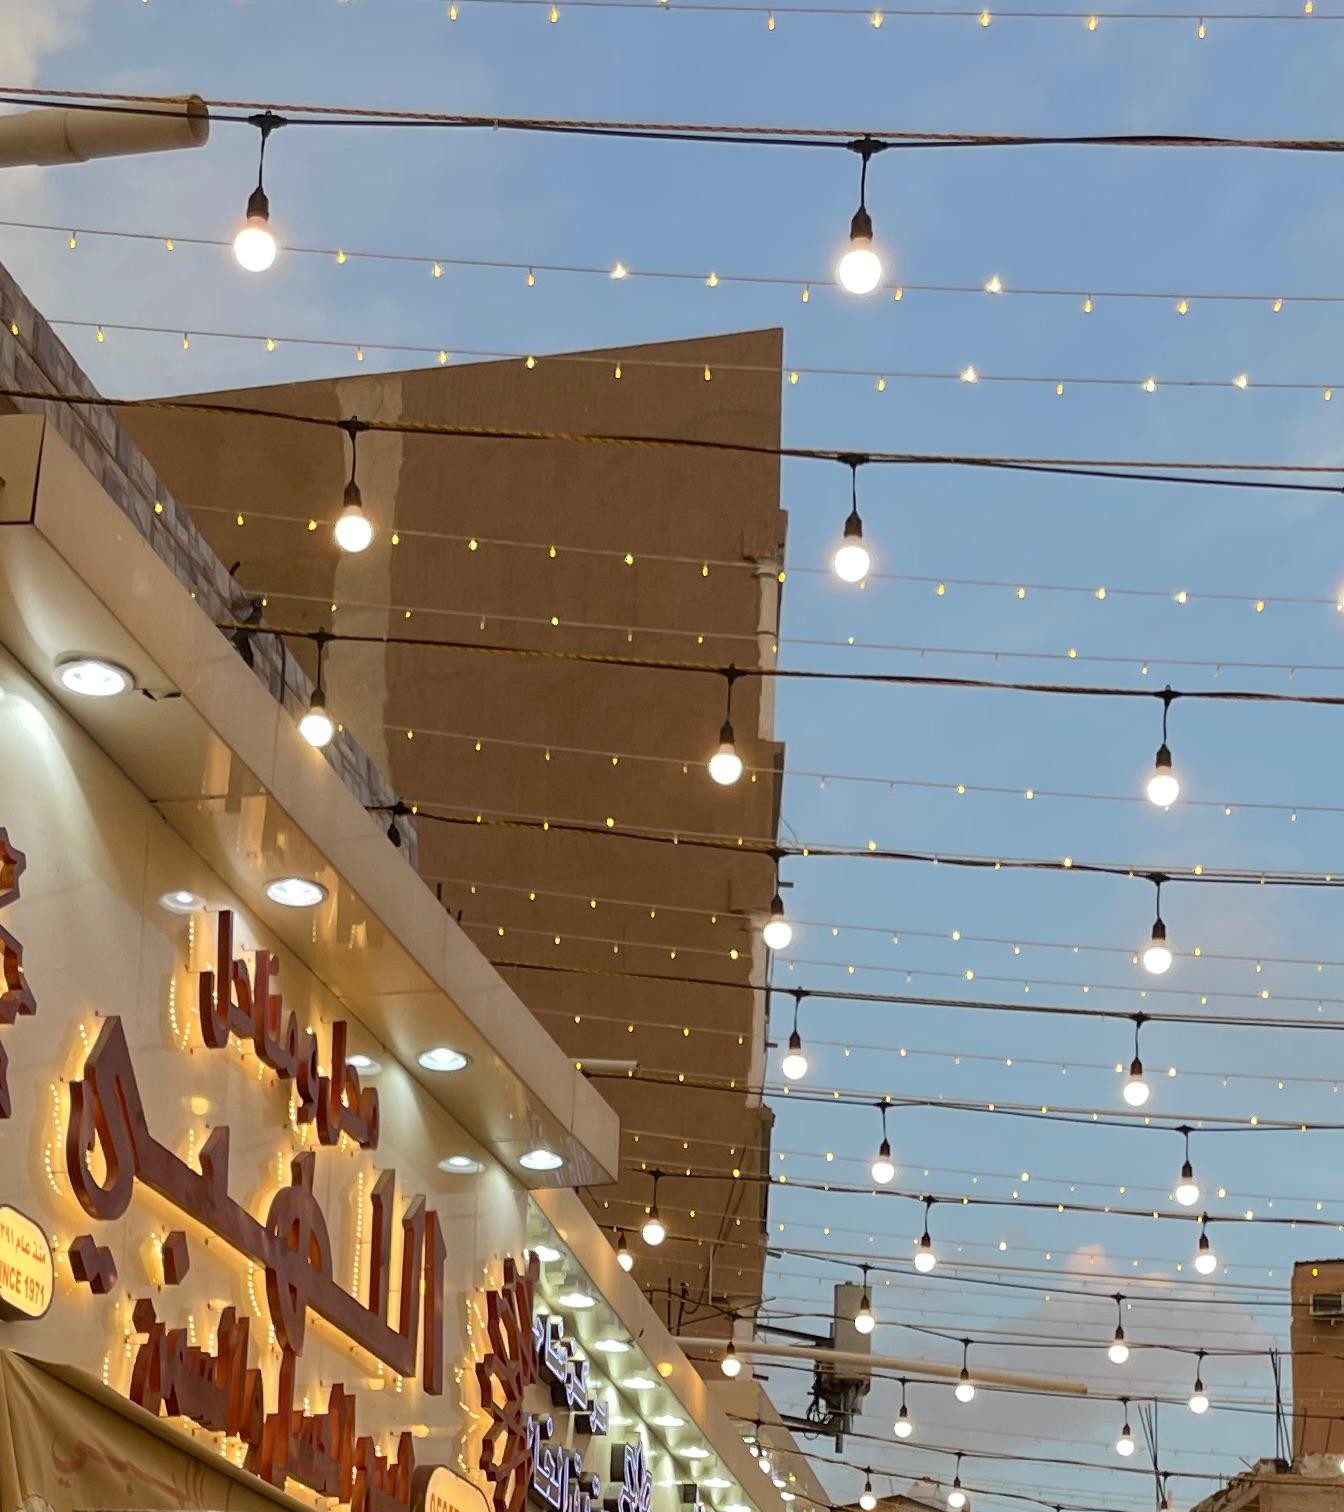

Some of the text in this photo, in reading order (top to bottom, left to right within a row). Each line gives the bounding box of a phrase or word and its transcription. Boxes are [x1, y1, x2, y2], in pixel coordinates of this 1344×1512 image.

[199, 908, 379, 1150] محل ومناحل
[16, 1233, 31, 1256] عام
[32, 1240, 46, 1264] منذ
[24, 1274, 46, 1309] 1971
